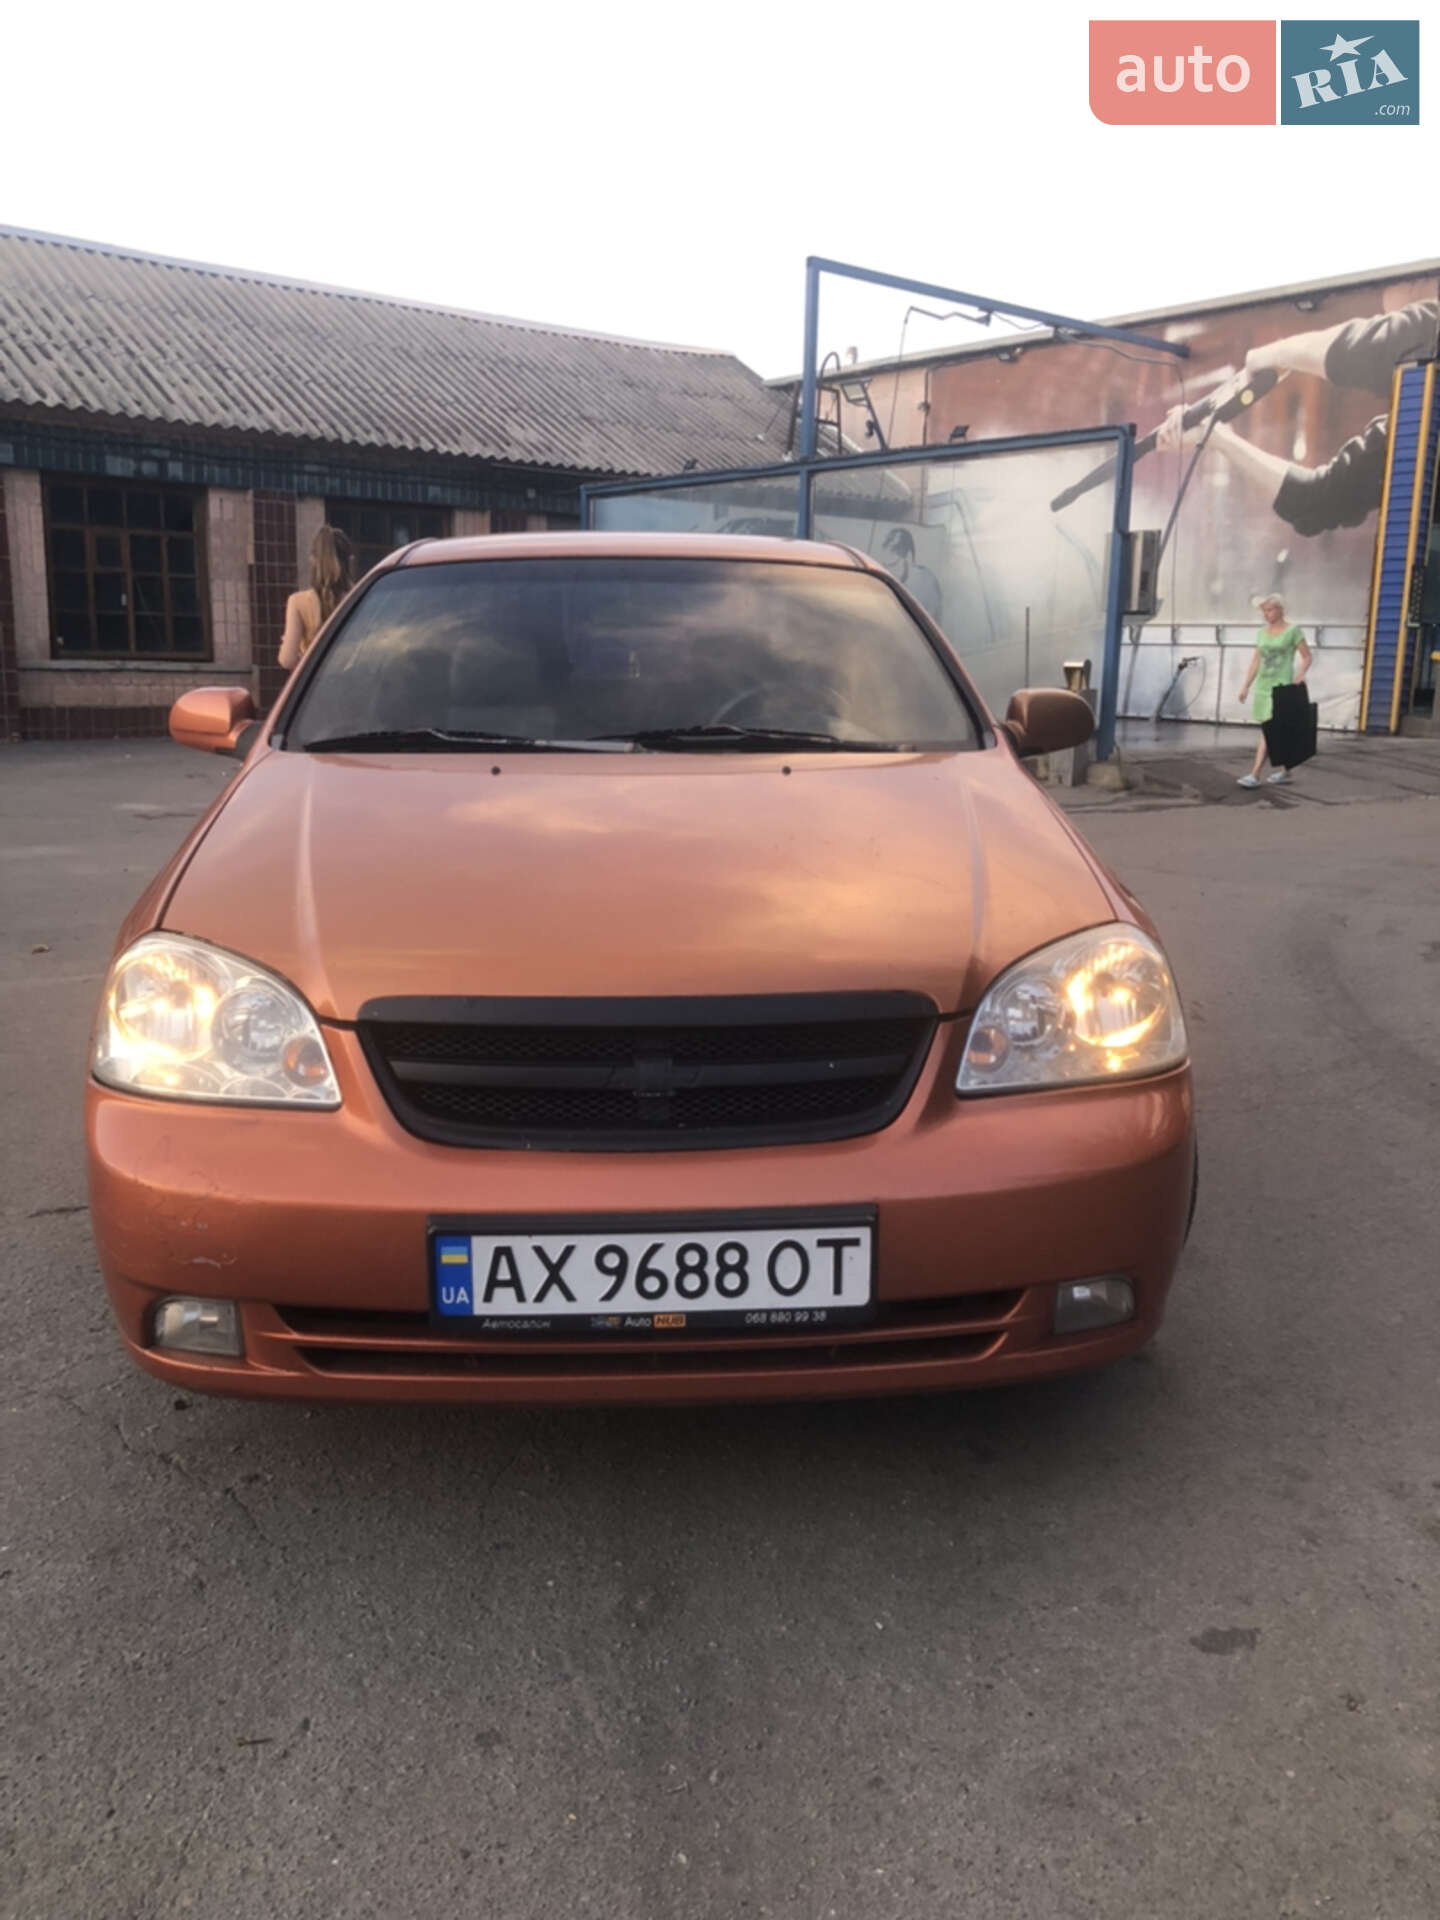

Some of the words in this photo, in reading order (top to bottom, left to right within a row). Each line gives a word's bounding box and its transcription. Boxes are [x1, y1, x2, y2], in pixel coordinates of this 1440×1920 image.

[482, 1244, 578, 1304] AX
[594, 1241, 750, 1303] 9688
[767, 1237, 861, 1299] OT
[441, 1287, 470, 1304] UA
[624, 1315, 652, 1329] Auto
